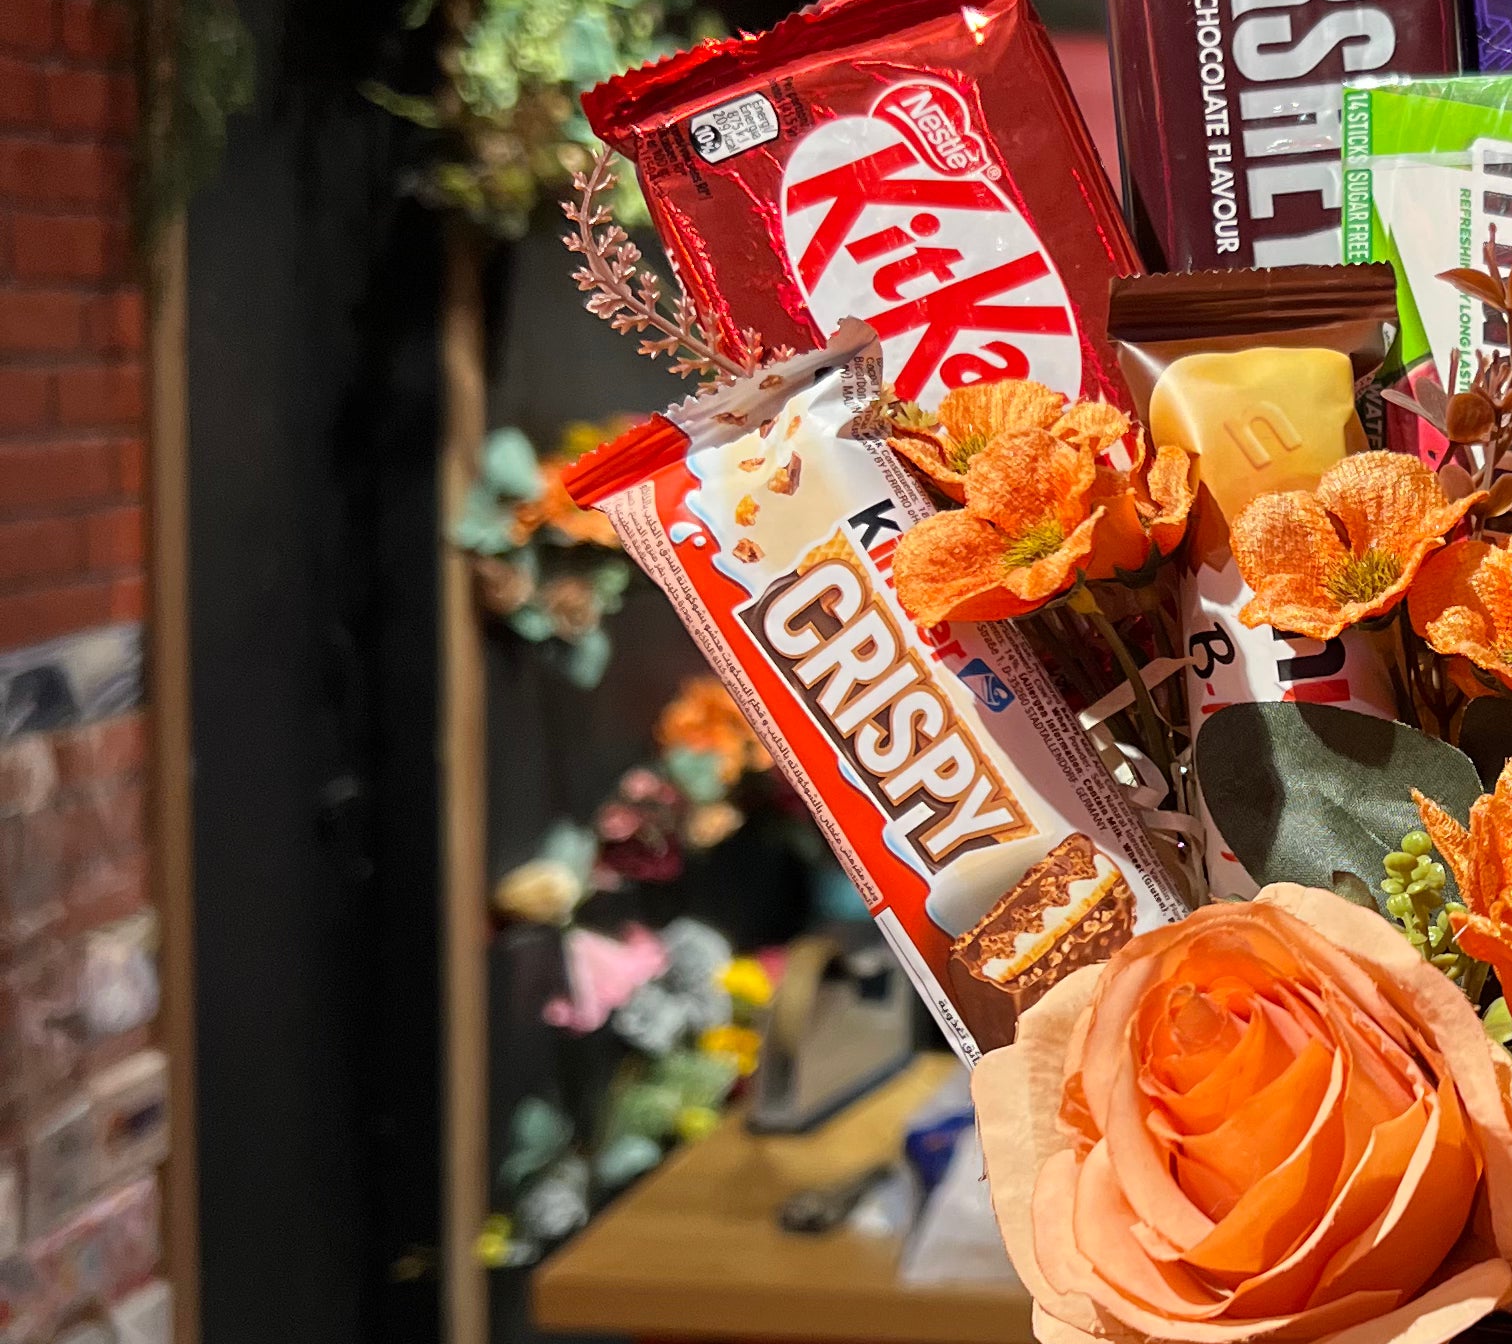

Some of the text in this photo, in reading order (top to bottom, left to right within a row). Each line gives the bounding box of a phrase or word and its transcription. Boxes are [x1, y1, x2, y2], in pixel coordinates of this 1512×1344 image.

[1347, 93, 1368, 162] 14 STICKS
[1205, 141, 1240, 254] FLAVOUR
[1347, 171, 1368, 259] SUGAR FREE
[1458, 305, 1472, 347] LONG
[873, 456, 886, 470] BY
[882, 468, 911, 509] FERRERO
[847, 497, 966, 681] Kier
[760, 559, 1018, 862] CRISPY
[1073, 786, 1107, 832] GERMANY
